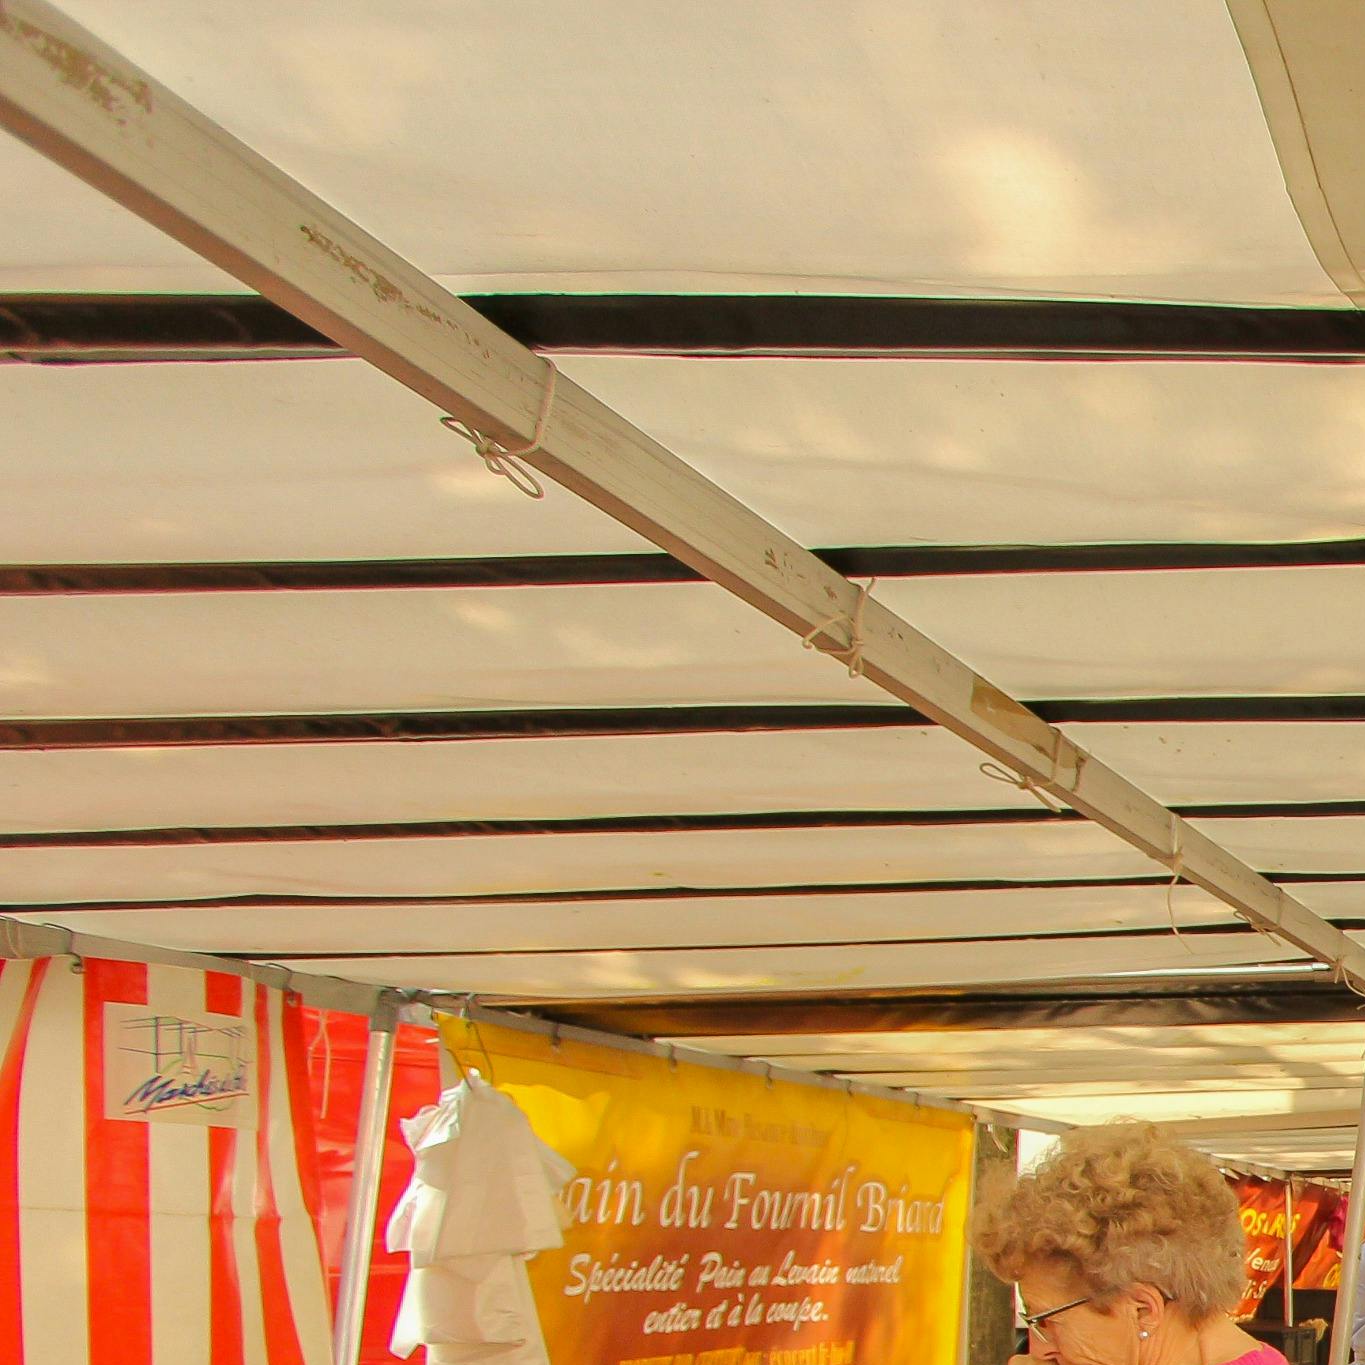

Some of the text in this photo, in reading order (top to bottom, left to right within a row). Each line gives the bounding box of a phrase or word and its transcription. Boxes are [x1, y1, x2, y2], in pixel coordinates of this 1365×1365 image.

[562, 1150, 945, 1234] ain du Fournil Briard
[564, 1250, 903, 1303] Spécialité Pain au Levain naturel
[643, 1302, 702, 1335] entier
[704, 1300, 728, 1330] et
[727, 1293, 744, 1328] à
[744, 1294, 762, 1327] la
